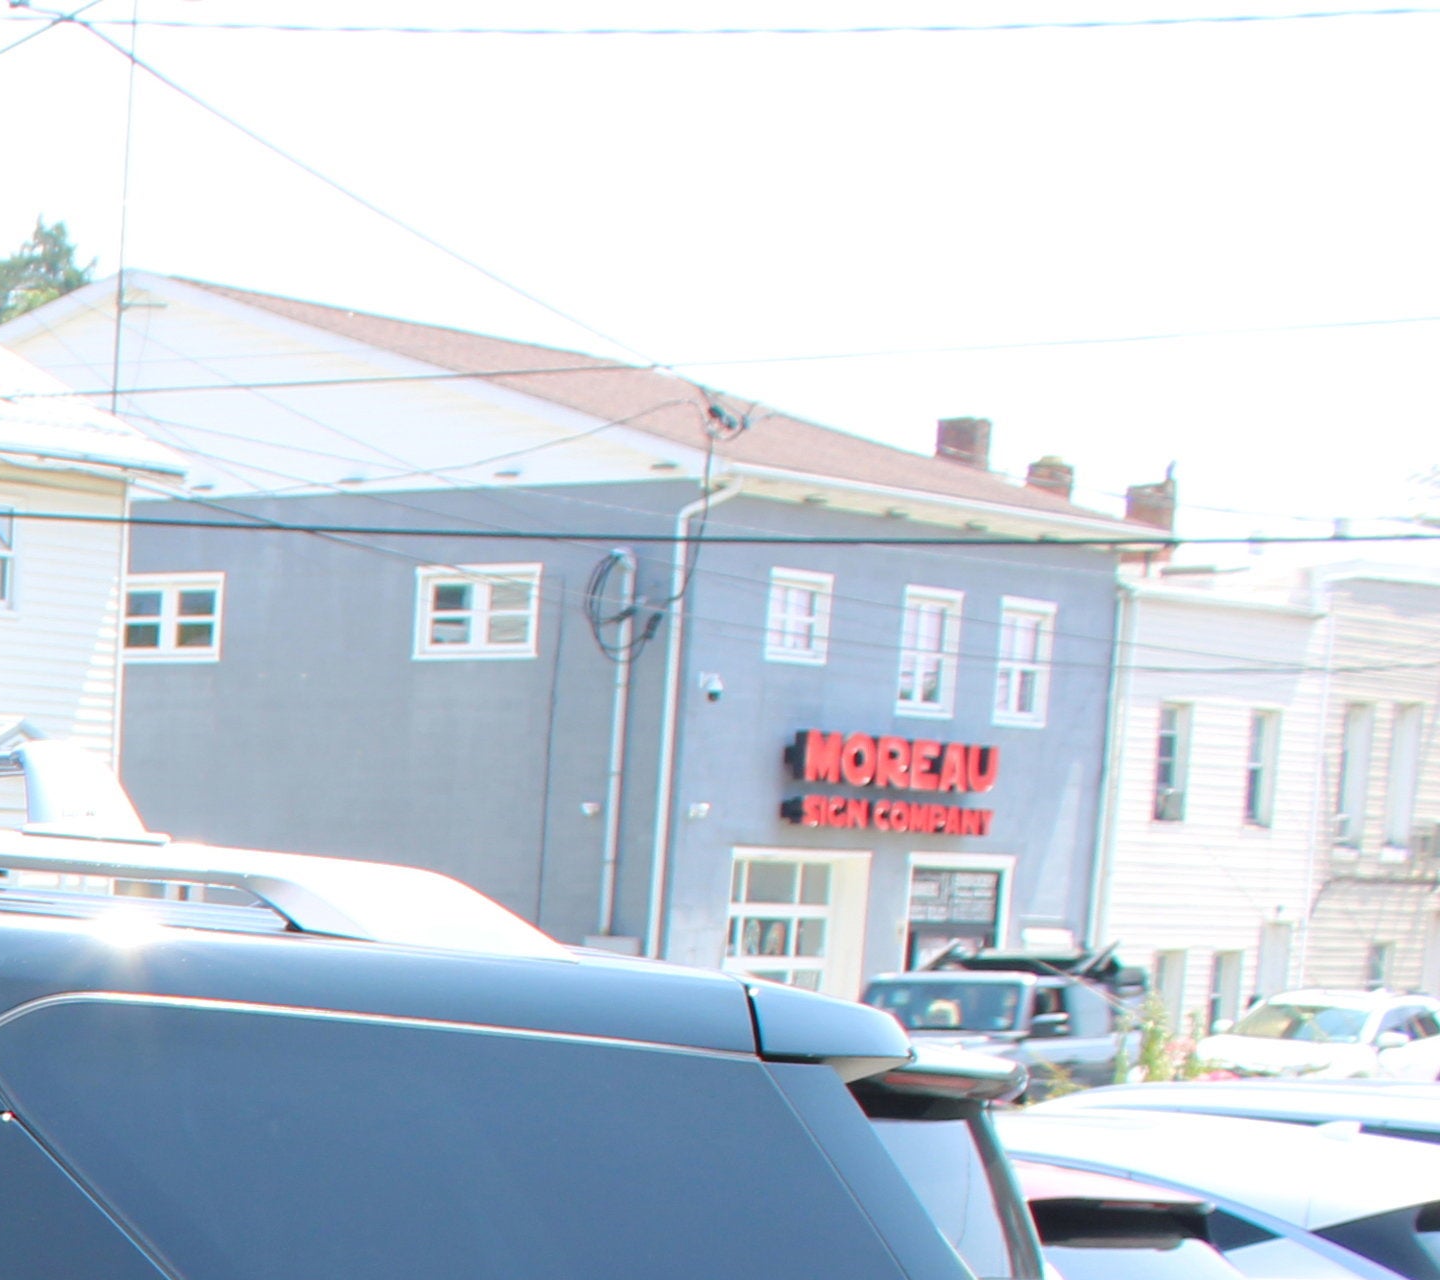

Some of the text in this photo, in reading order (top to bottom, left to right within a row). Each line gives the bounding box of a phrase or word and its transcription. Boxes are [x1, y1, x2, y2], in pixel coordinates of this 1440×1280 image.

[805, 728, 1000, 793] MOREAU
[801, 793, 995, 837] SIGN COMPANY
